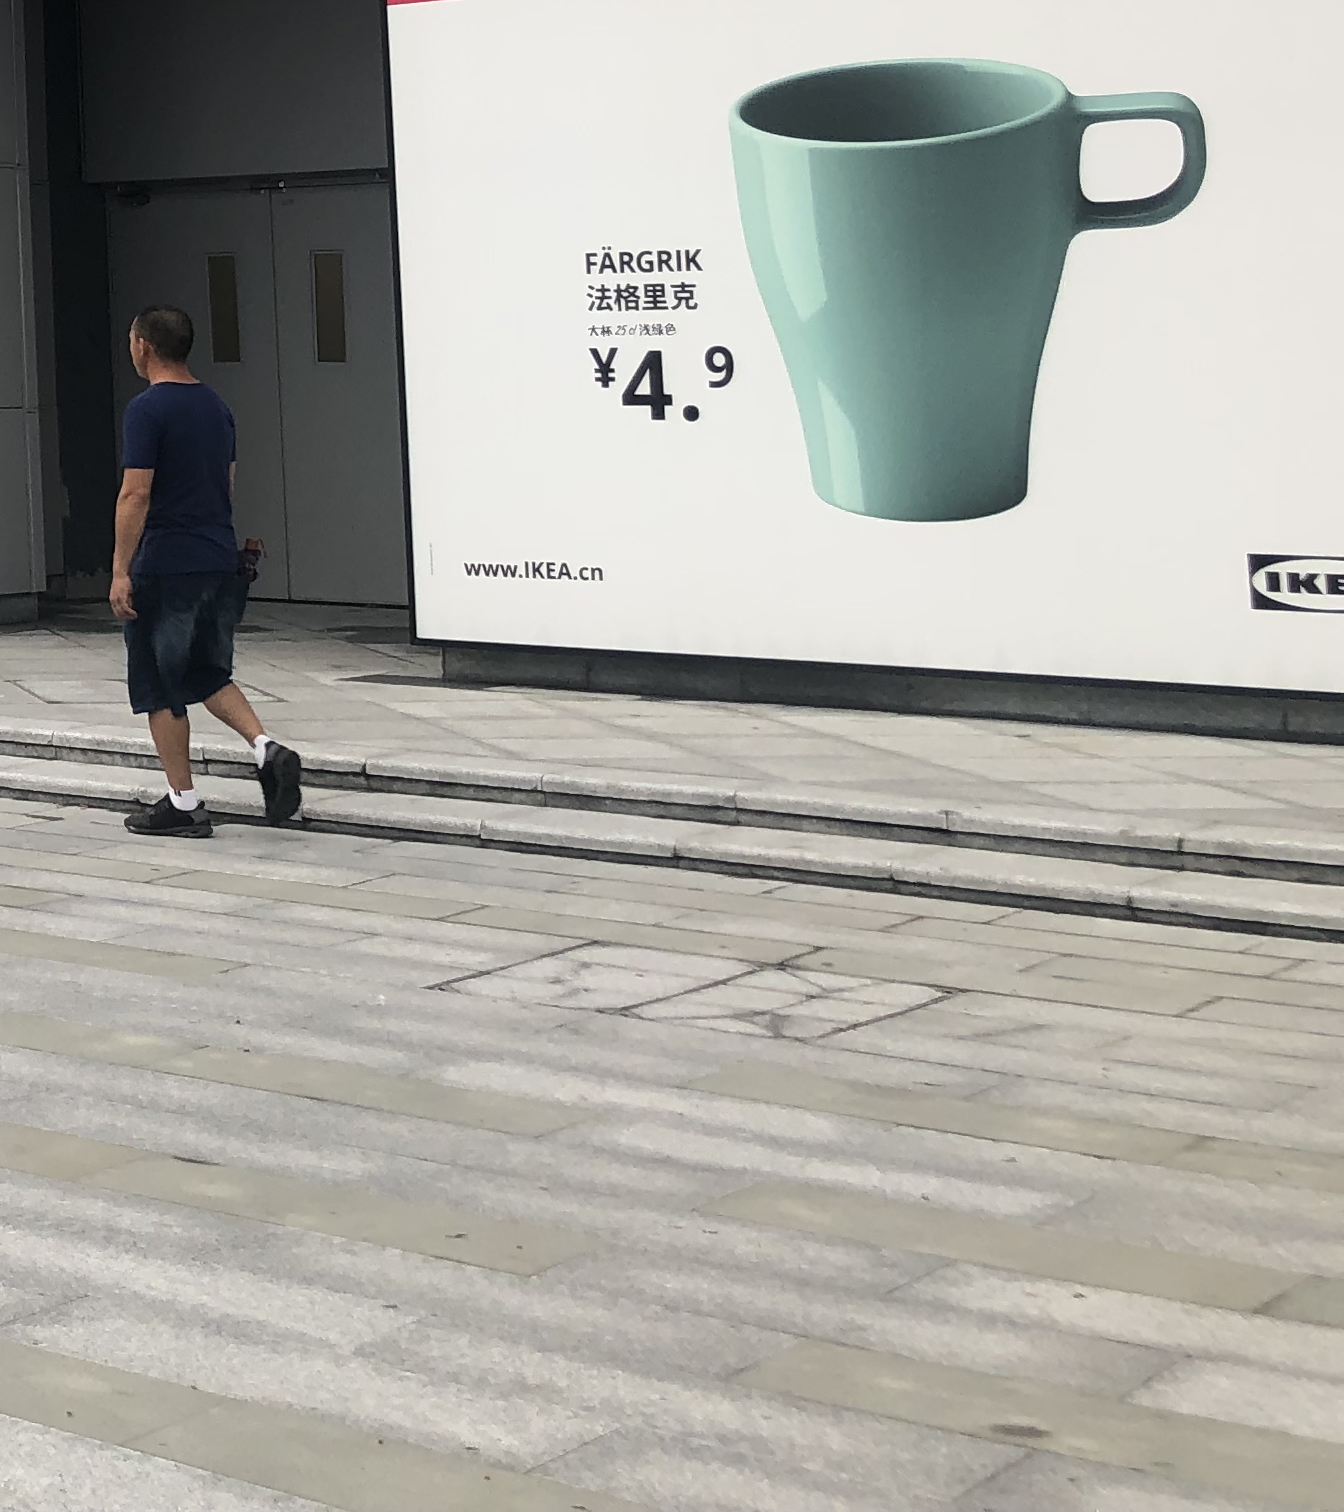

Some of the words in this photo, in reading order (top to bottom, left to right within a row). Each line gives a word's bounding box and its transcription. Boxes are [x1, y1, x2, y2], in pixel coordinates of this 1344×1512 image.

[585, 246, 703, 274] FÄRGRIK
[586, 282, 699, 311] 法格里克
[463, 561, 604, 581] www.IKEA.cn
[1264, 571, 1344, 595] IKE
